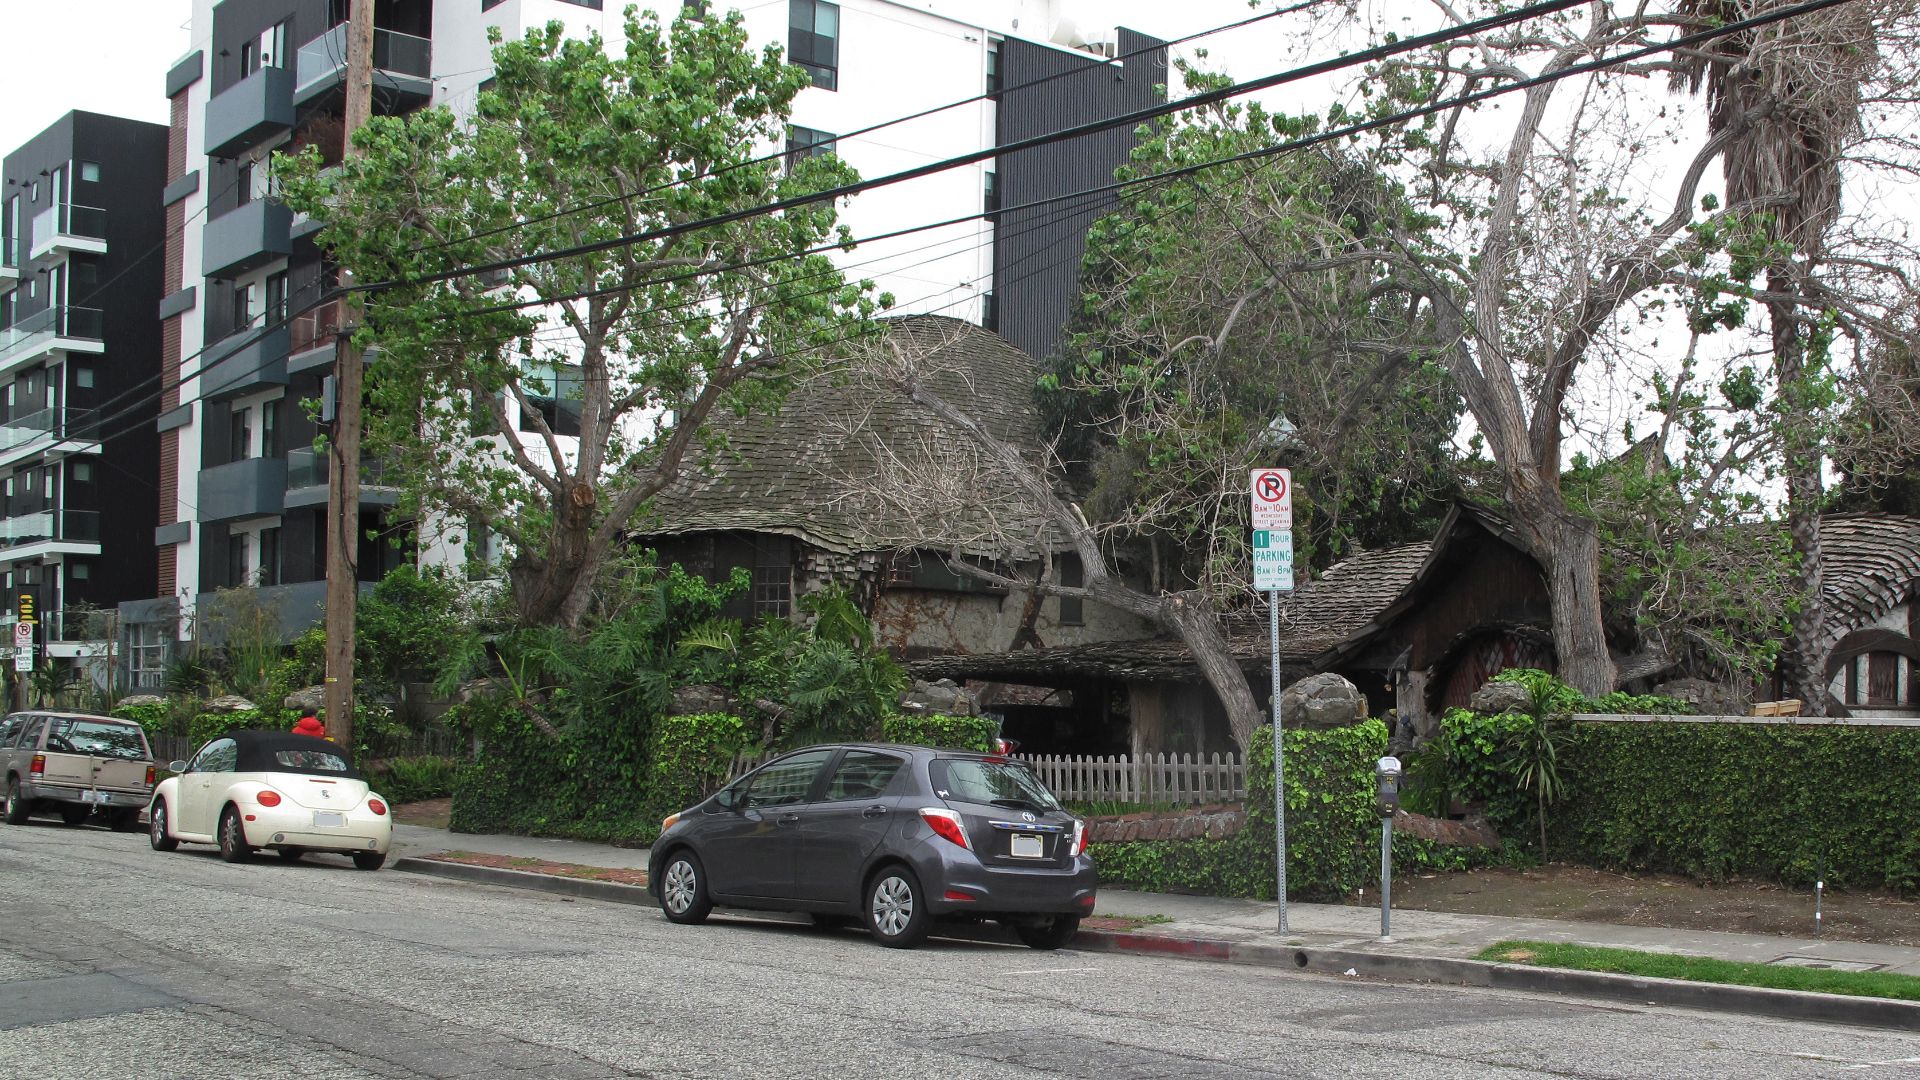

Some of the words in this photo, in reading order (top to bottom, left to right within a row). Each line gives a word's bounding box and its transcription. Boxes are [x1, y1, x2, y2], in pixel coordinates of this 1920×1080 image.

[1254, 503, 1267, 513] 8AM
[1273, 503, 1289, 513] 10AM
[1259, 533, 1264, 546] 1
[1270, 534, 1290, 543] HOUR
[1255, 550, 1291, 562] PARKING
[1256, 565, 1270, 575] 8AM
[1277, 564, 1291, 575] 8PM
